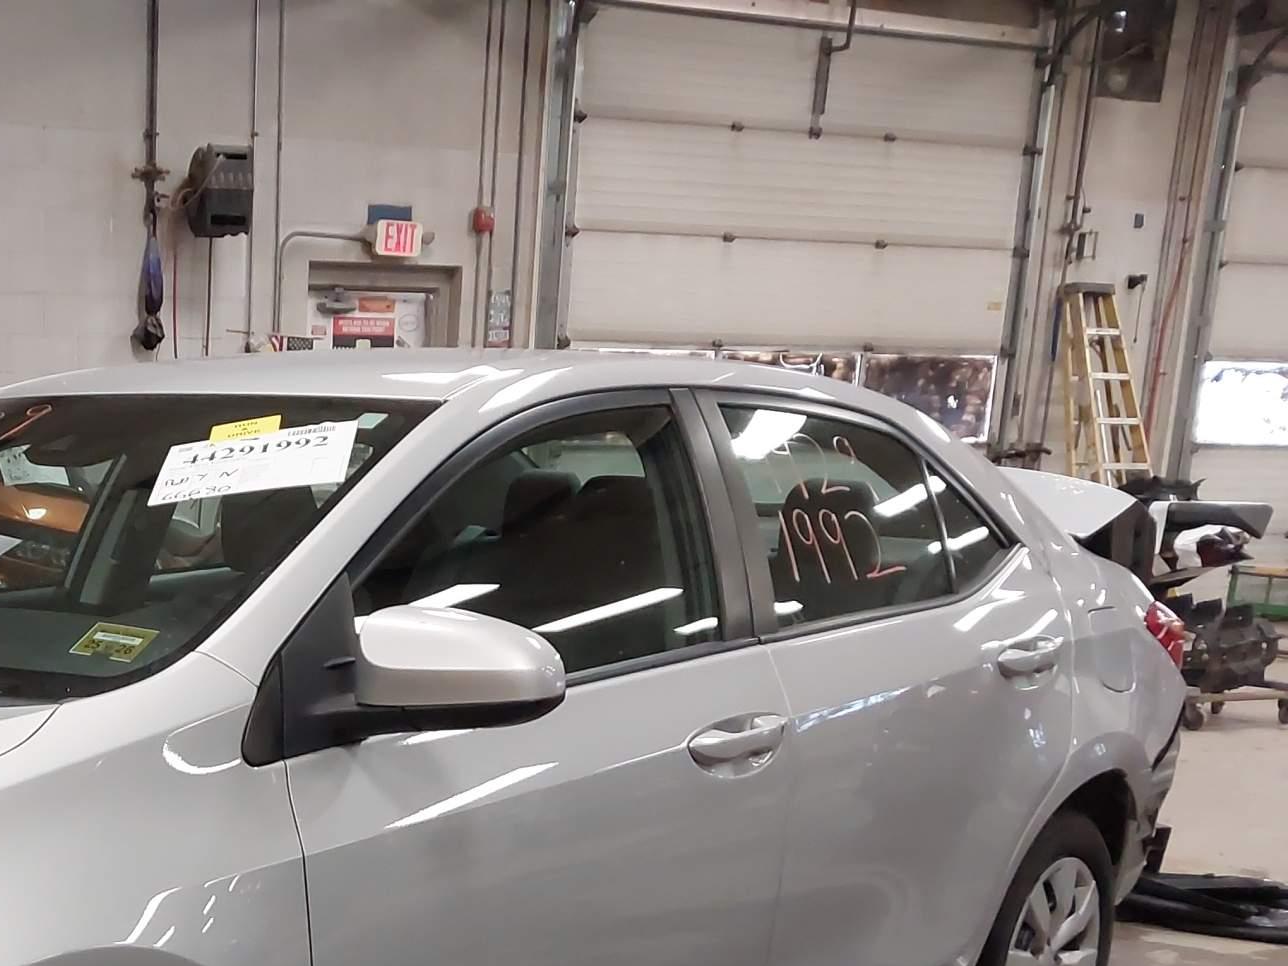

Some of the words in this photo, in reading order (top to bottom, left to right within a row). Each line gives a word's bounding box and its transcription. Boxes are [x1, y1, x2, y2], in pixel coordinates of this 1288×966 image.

[384, 222, 417, 253] EXIT
[182, 435, 329, 464] 44291992
[778, 508, 907, 584] 1992
